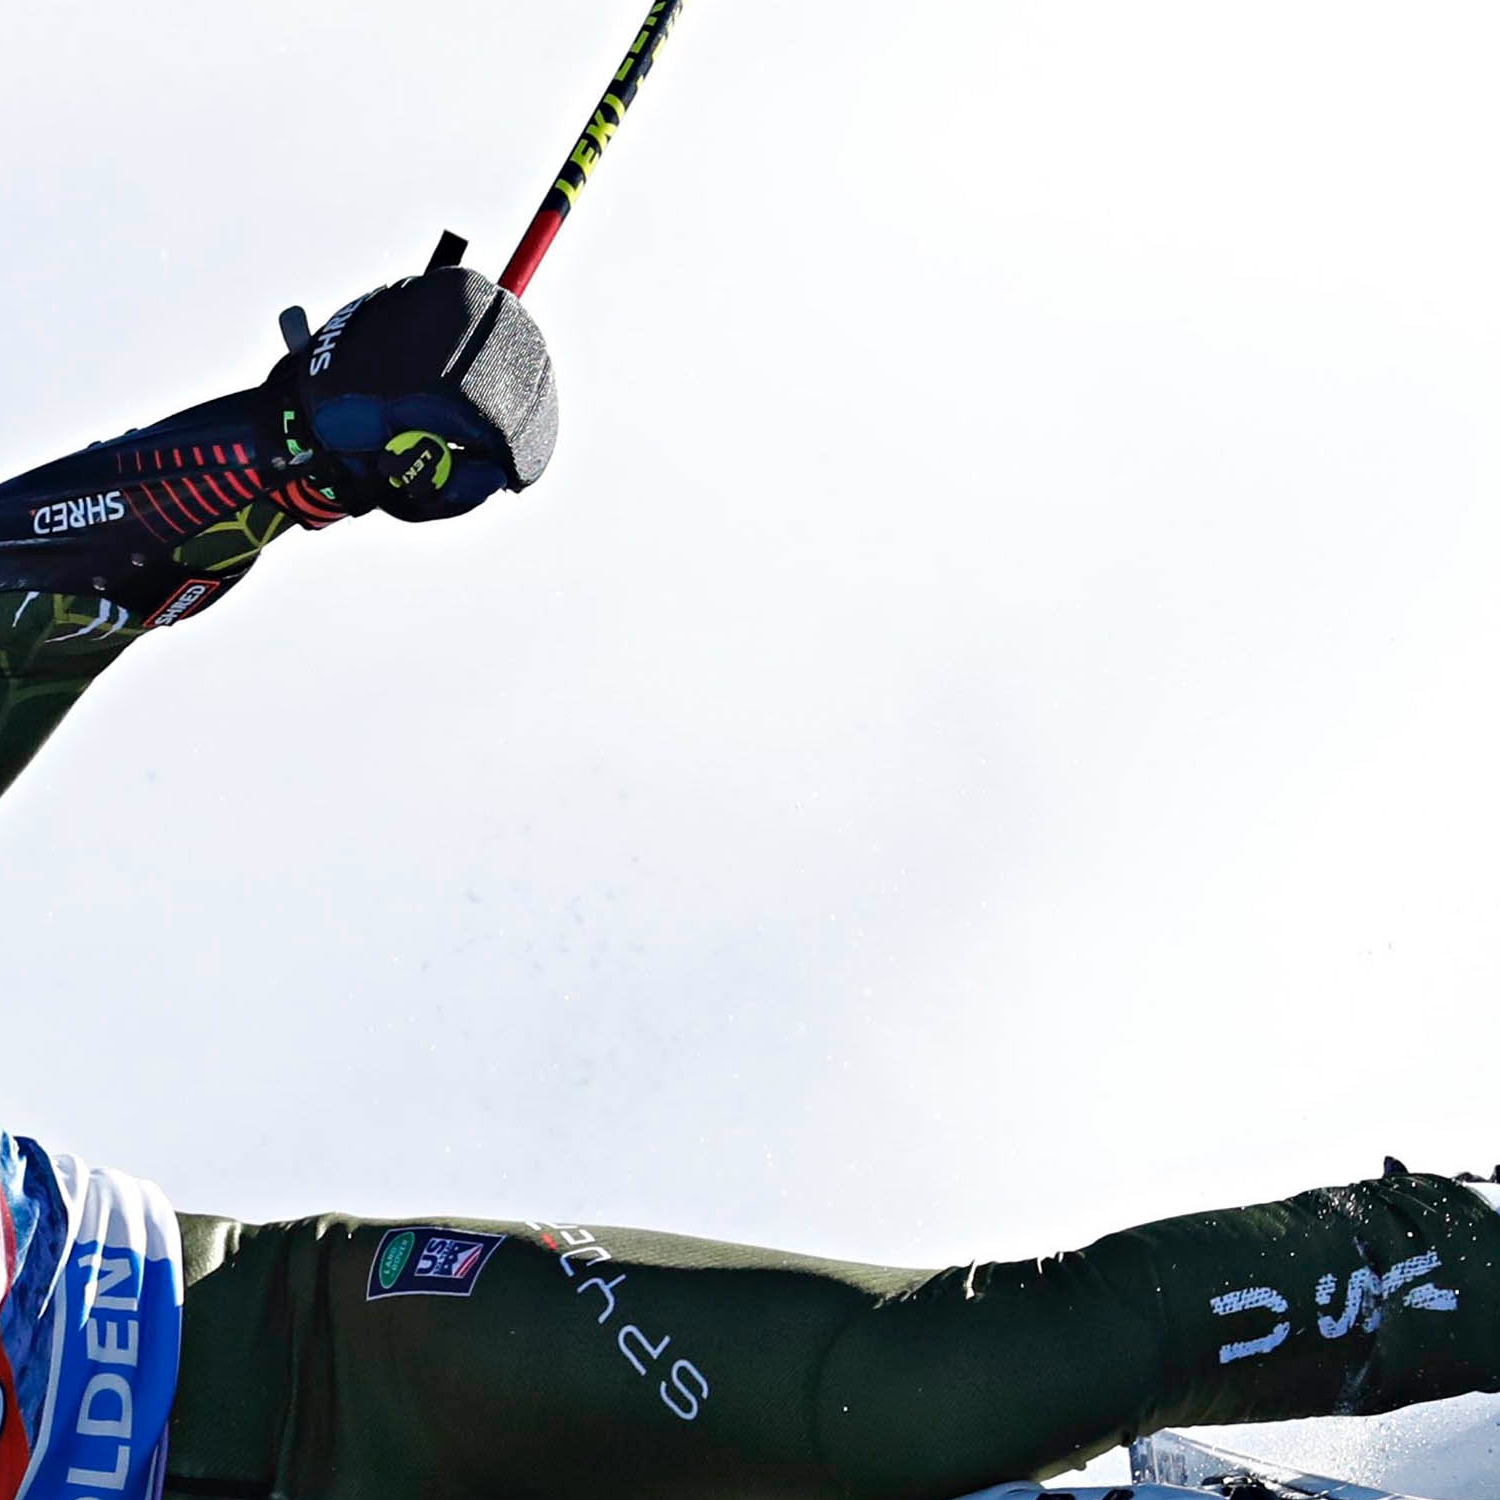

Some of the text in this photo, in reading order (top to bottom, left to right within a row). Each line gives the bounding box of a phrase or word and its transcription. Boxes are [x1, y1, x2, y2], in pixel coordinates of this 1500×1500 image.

[555, 92, 626, 205] LEKI
[402, 450, 432, 484] LEKI
[32, 490, 125, 534] SHRED
[155, 585, 206, 625] SHRED
[416, 1239, 447, 1275] US
[1210, 1250, 1458, 1364] USA
